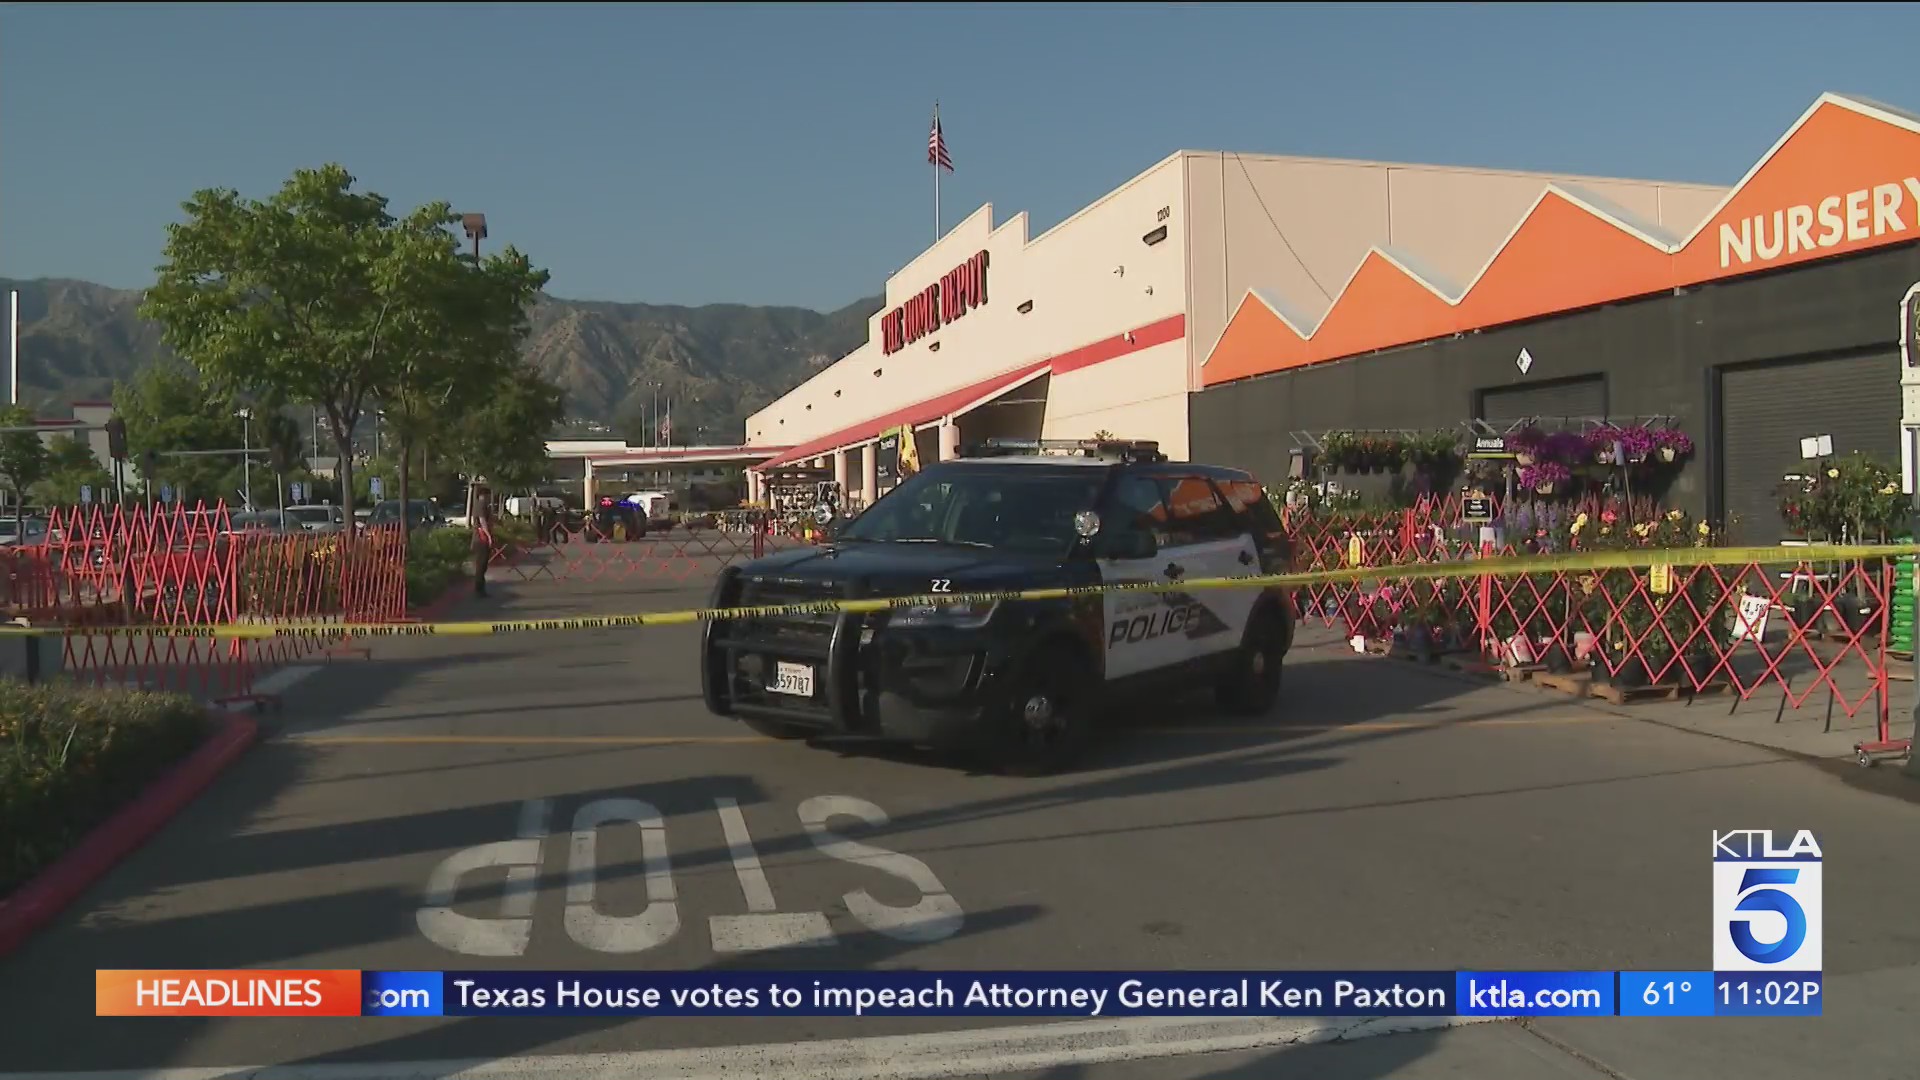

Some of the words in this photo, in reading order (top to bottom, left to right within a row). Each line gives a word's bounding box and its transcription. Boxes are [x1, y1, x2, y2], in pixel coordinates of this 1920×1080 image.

[1719, 177, 1920, 268] NURSERY
[881, 306, 905, 357] THE
[903, 283, 941, 345] HOME
[940, 249, 990, 325] DEPOT
[1476, 437, 1504, 448] Annuals
[931, 578, 952, 592] 22
[1108, 603, 1201, 650] POLICE
[416, 794, 964, 956] STOP
